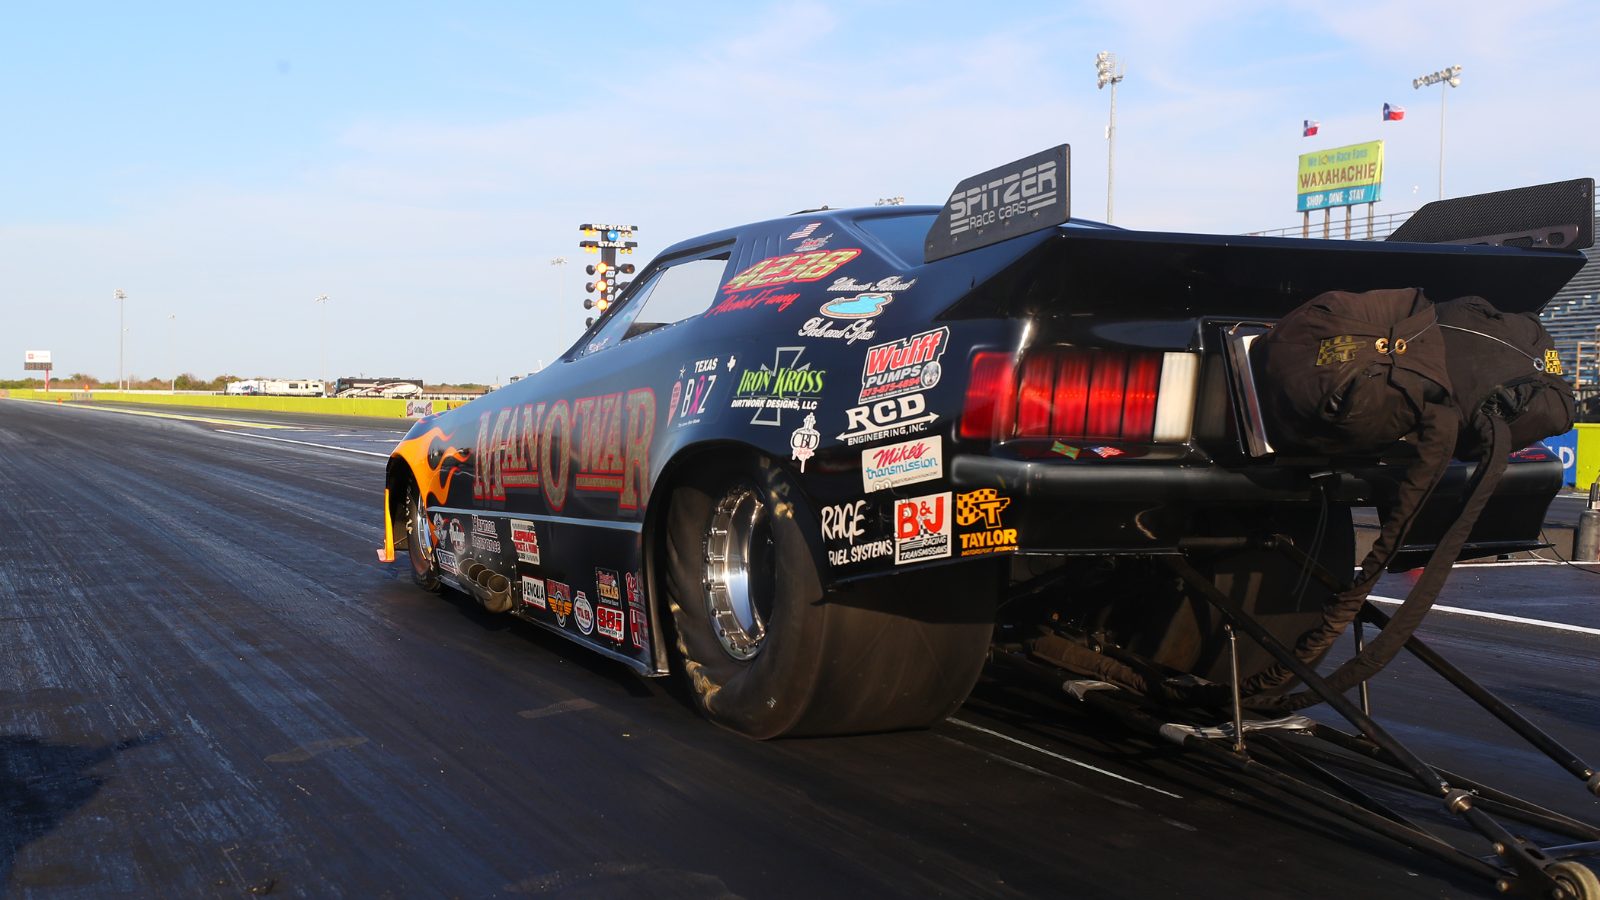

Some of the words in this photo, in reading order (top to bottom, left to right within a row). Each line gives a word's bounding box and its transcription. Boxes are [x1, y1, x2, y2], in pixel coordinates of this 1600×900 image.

[1300, 162, 1376, 188] WAXAHACHIE
[950, 160, 1056, 221] SPITZER
[1306, 194, 1324, 207] SHOP
[1348, 188, 1366, 201] STAY
[722, 249, 862, 293] 4238
[694, 358, 719, 374] TEXAS
[866, 331, 943, 376] Wulff
[736, 368, 772, 398] IRON
[772, 367, 826, 400] KROSS
[866, 364, 922, 388] PUMPS
[731, 400, 766, 409] DIRTWORK
[766, 400, 800, 411] DESIGNS,
[802, 400, 818, 410] LLC
[846, 393, 926, 430] RCD
[872, 440, 932, 468] Mike's
[866, 456, 938, 480] transmission
[897, 496, 945, 540] B&J
[922, 535, 948, 547] RACING
[960, 528, 1018, 550] TAYLOR
[828, 549, 850, 568] FUEL
[850, 540, 894, 564] SYSTEMS
